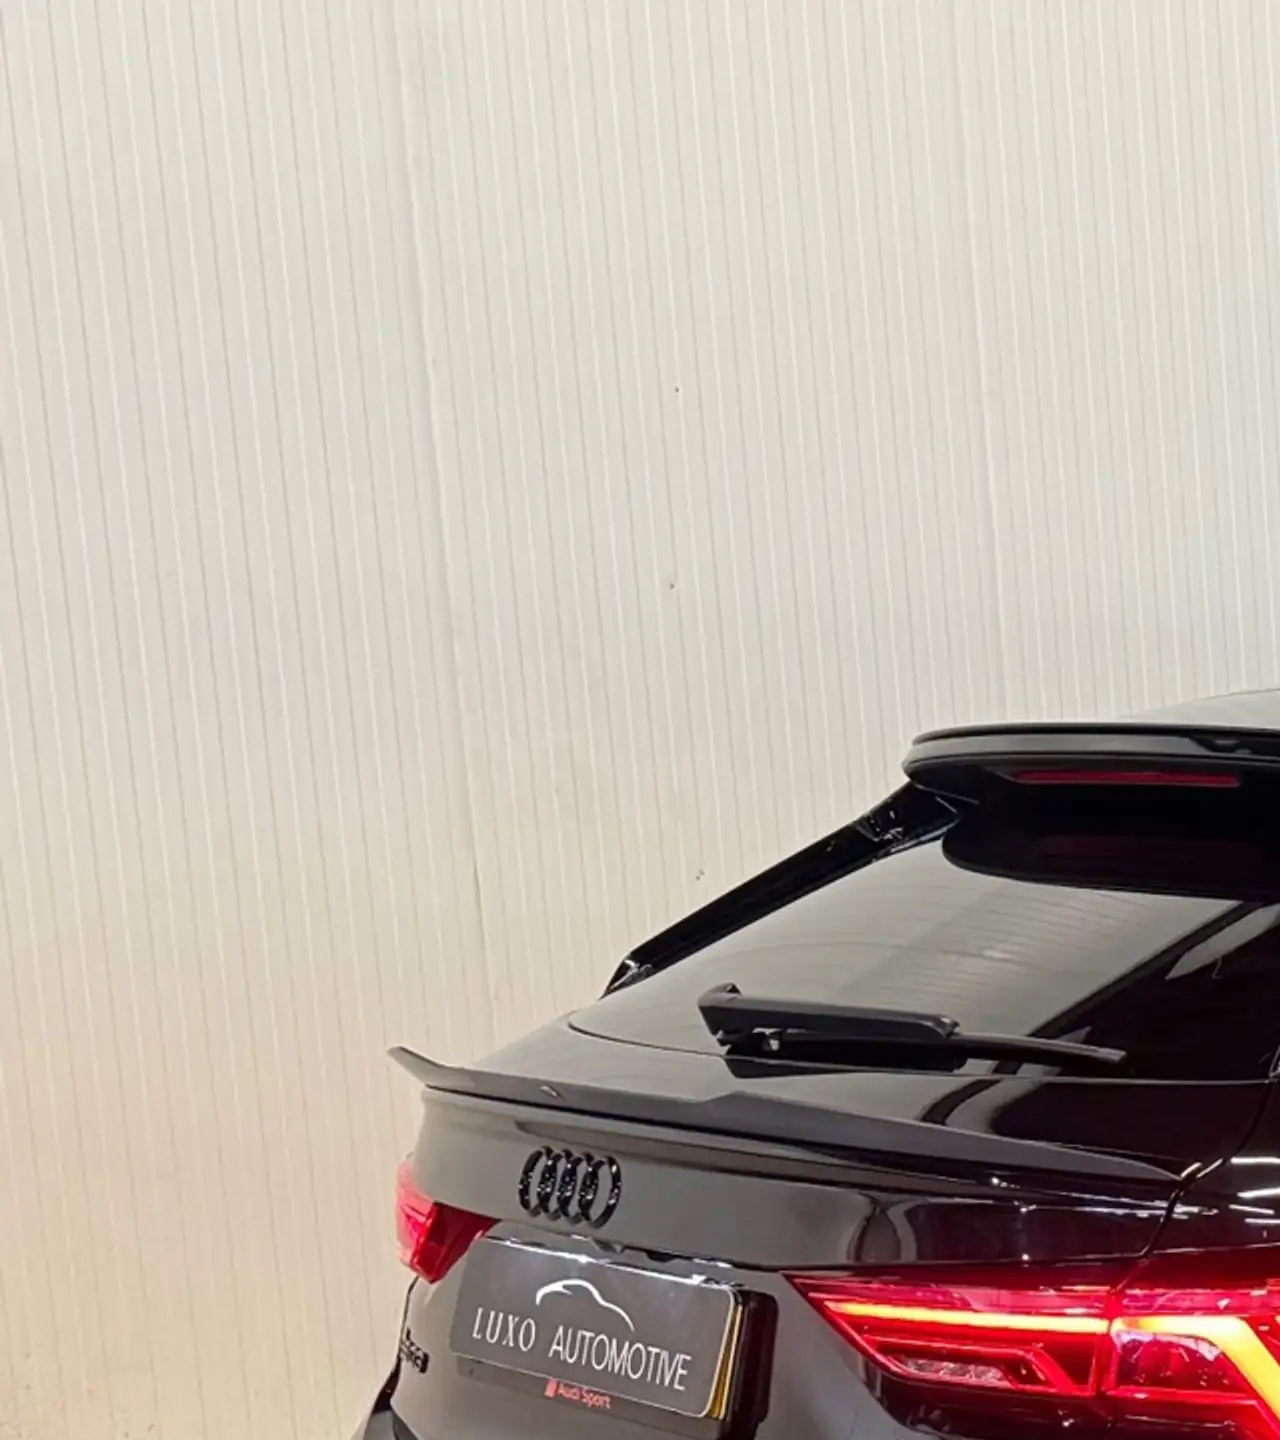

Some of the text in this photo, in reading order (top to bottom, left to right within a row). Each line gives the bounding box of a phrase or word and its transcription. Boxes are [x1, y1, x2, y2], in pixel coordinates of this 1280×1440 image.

[472, 1307, 536, 1352] LUXO
[548, 1325, 692, 1391] AUTOMOTIVE
[582, 1387, 611, 1409] Sport
